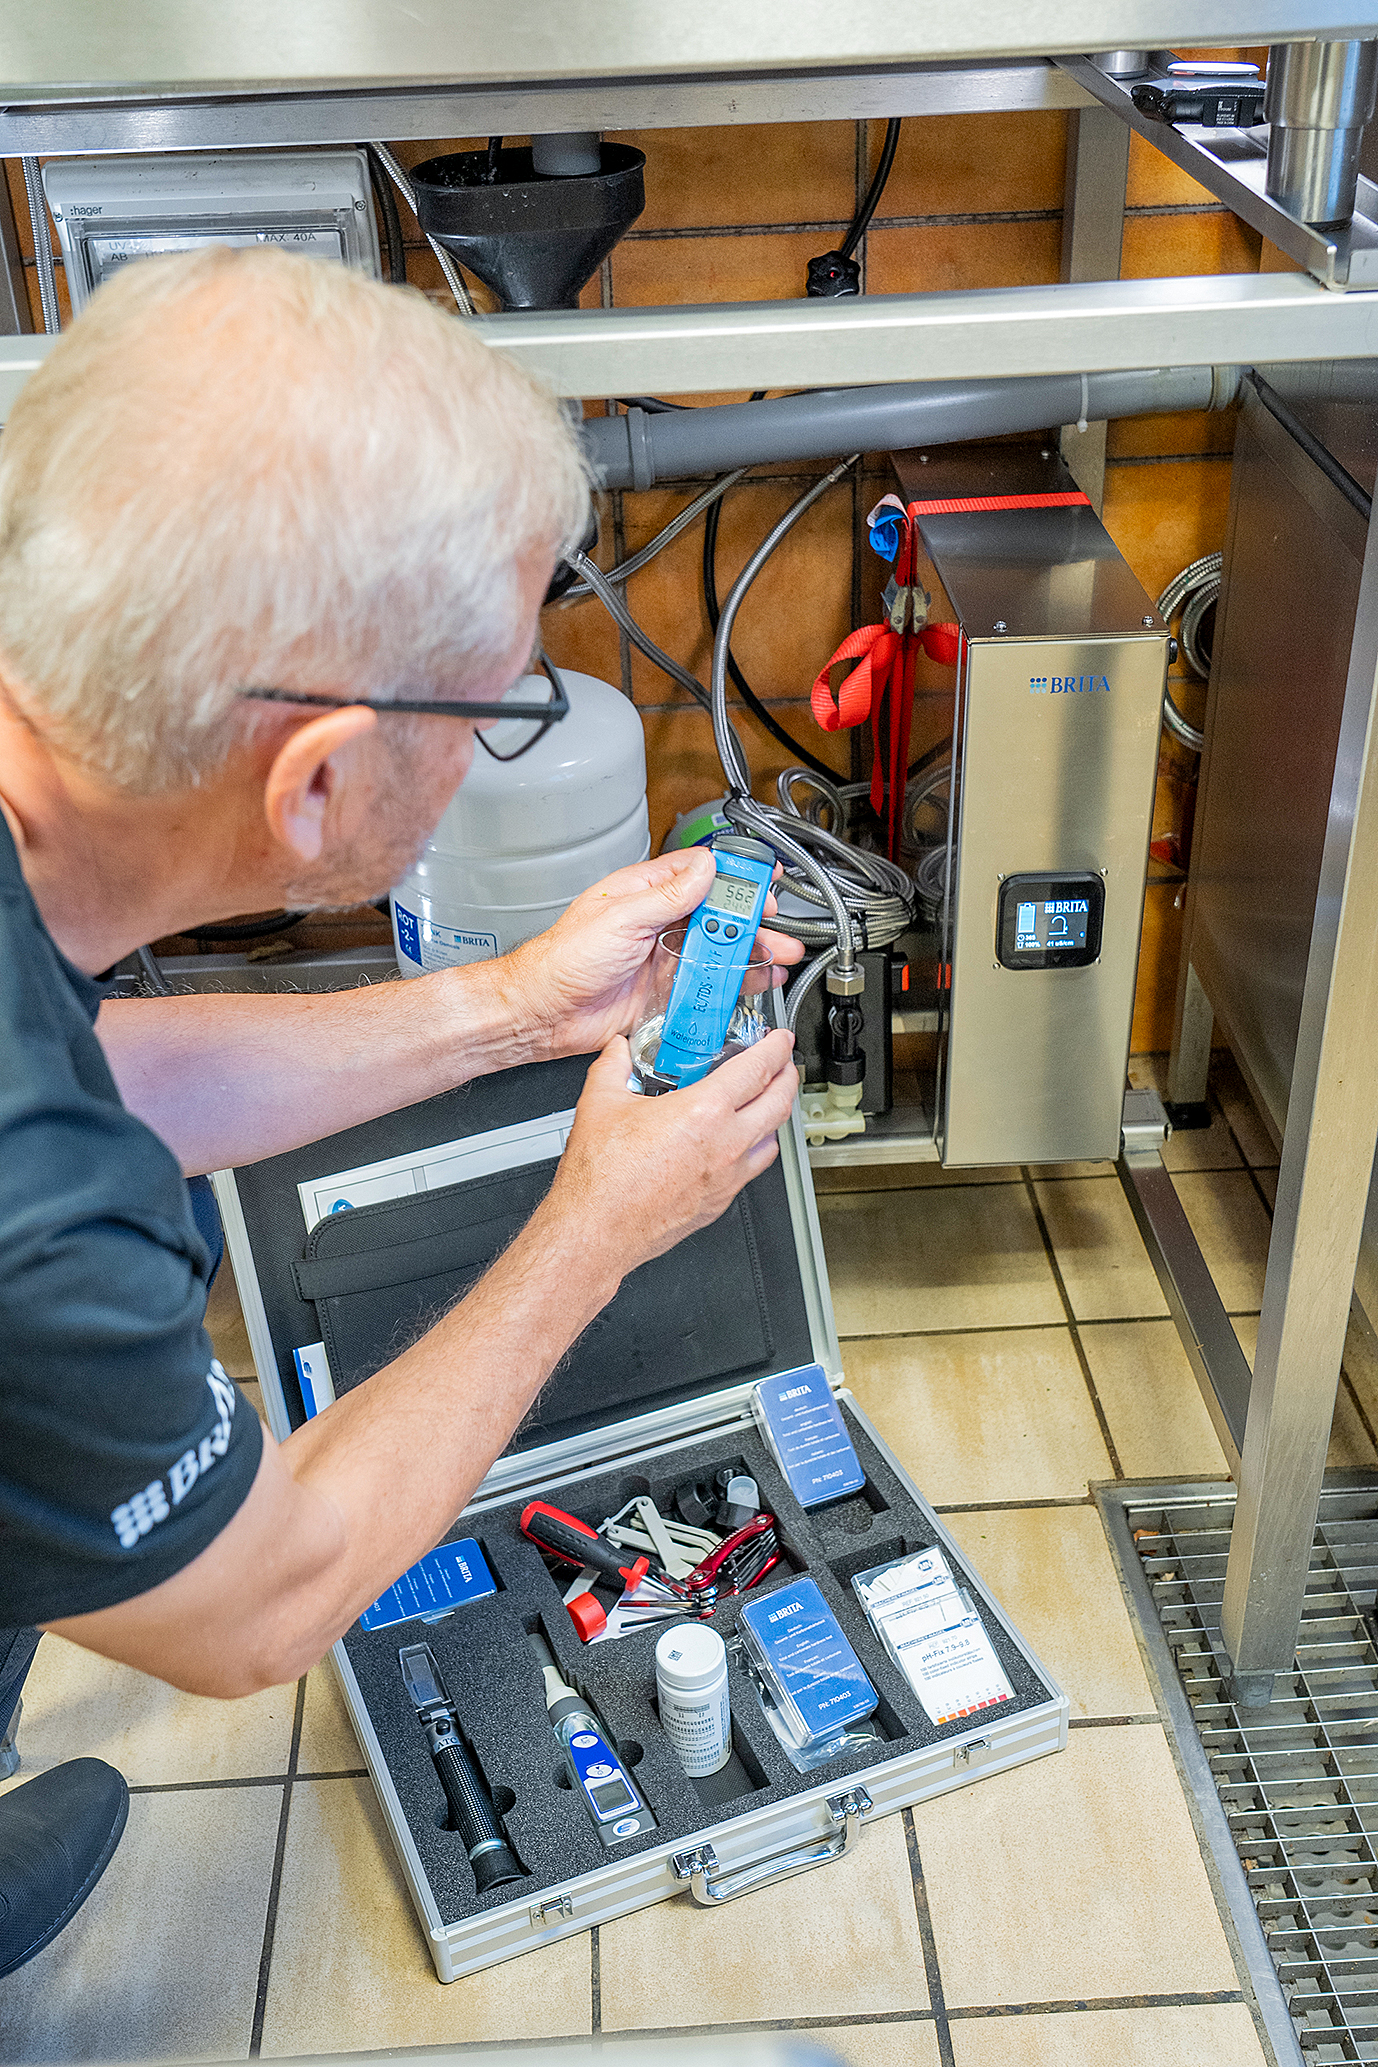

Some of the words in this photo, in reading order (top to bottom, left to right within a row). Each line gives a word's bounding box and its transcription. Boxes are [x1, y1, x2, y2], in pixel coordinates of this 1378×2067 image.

[293, 232, 316, 242] 40A
[1050, 674, 1110, 694] BRITA
[725, 884, 755, 903] 562
[1055, 901, 1088, 914] BRITA
[462, 936, 490, 947] BRITA
[670, 1029, 711, 1047] waterproof
[786, 1385, 812, 1399] BRITA
[822, 1470, 844, 1481] 710403
[457, 1562, 473, 1584] BRITA
[776, 1602, 804, 1620] BRITA
[921, 1649, 945, 1663] pH-Fix
[829, 1691, 852, 1705] 710403
[437, 1736, 458, 1750] ATC
